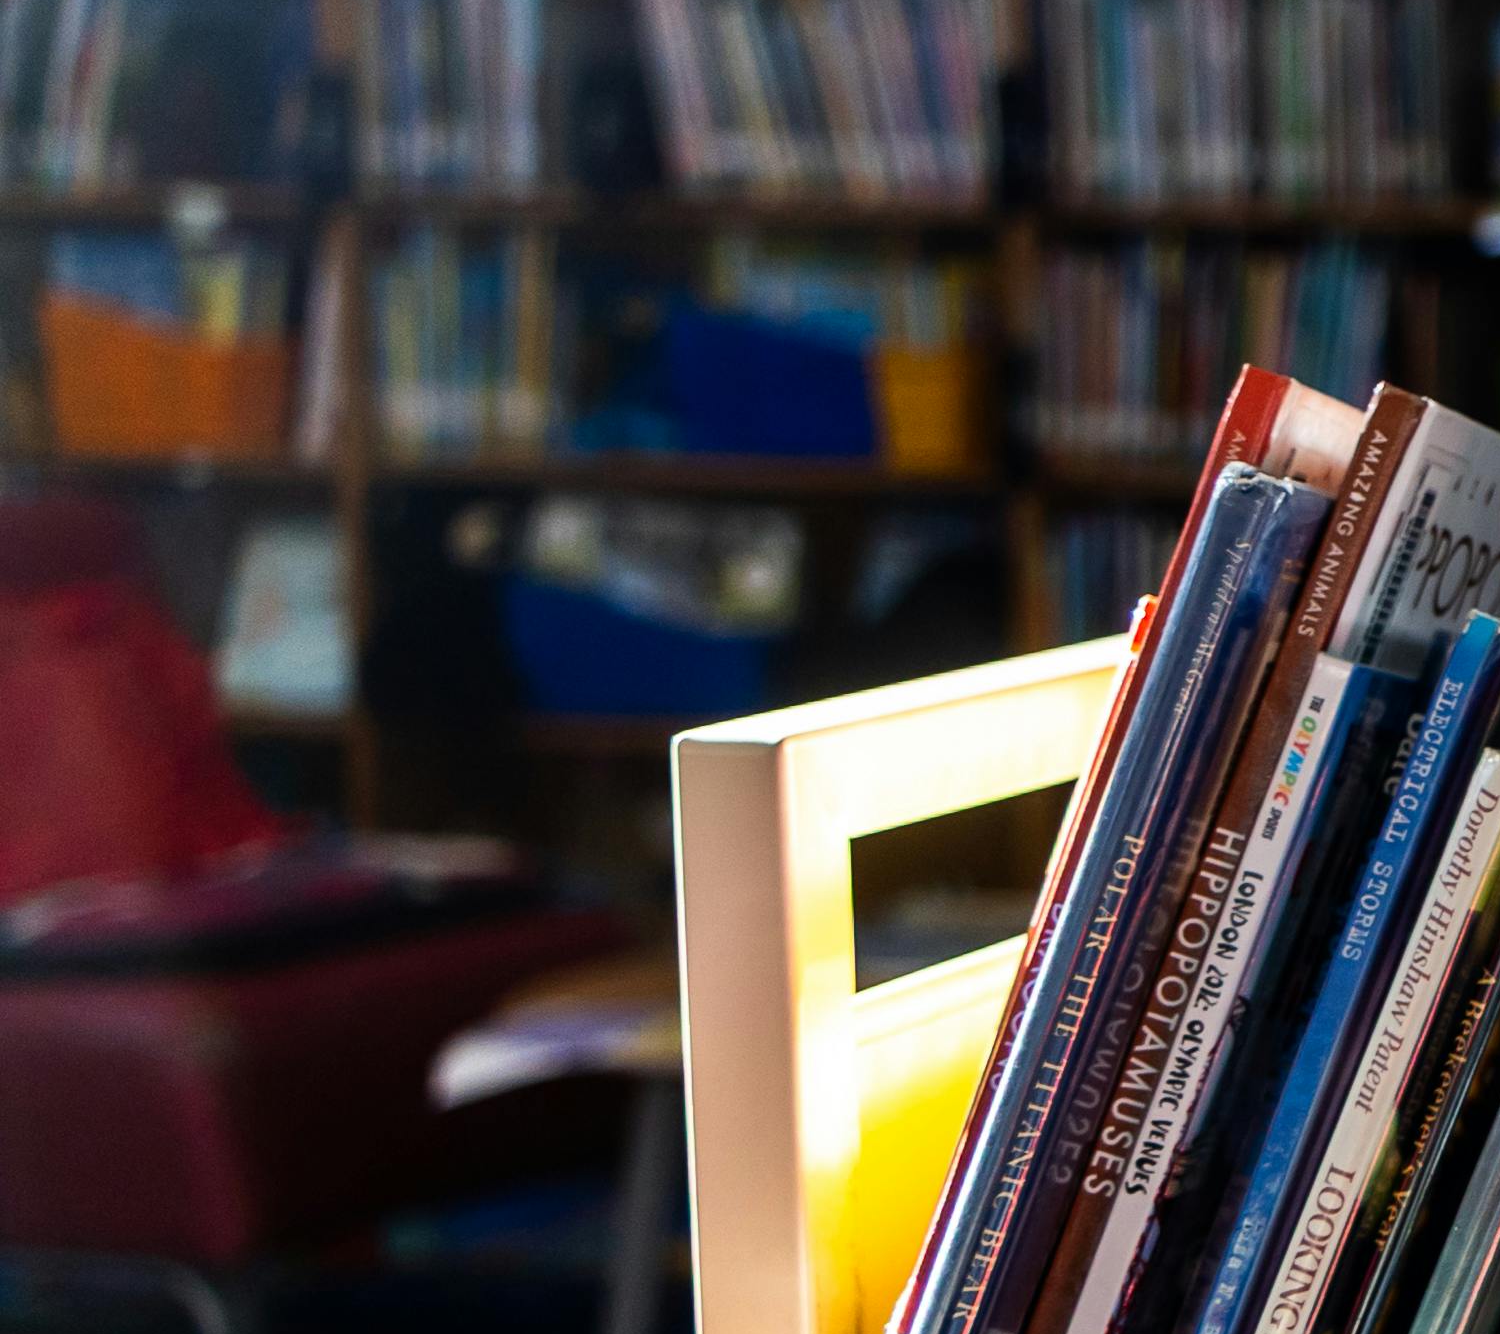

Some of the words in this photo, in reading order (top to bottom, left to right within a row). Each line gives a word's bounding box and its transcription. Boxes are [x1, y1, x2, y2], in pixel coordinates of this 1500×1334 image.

[1295, 542, 1346, 639] ANIMALS
[1382, 676, 1463, 846] ELECTRICAL
[1434, 784, 1500, 898] Dorothy
[1083, 832, 1146, 955] POLAR
[1213, 869, 1265, 962] LONDON
[1338, 860, 1394, 963] STORMS
[1052, 970, 1096, 1043] THE
[1079, 825, 1246, 1201] HIPPOPOTAMUSES
[1193, 964, 1229, 1015] 2012:
[1386, 900, 1456, 1028] Hinshaw
[1155, 1017, 1209, 1113] OLYMPIC
[1351, 1028, 1404, 1116] Patent
[989, 1052, 1067, 1216] TITANIC
[1122, 1115, 1171, 1200] VENUES
[950, 1225, 1005, 1324] BEAR
[1267, 1161, 1355, 1332] LOOKING
